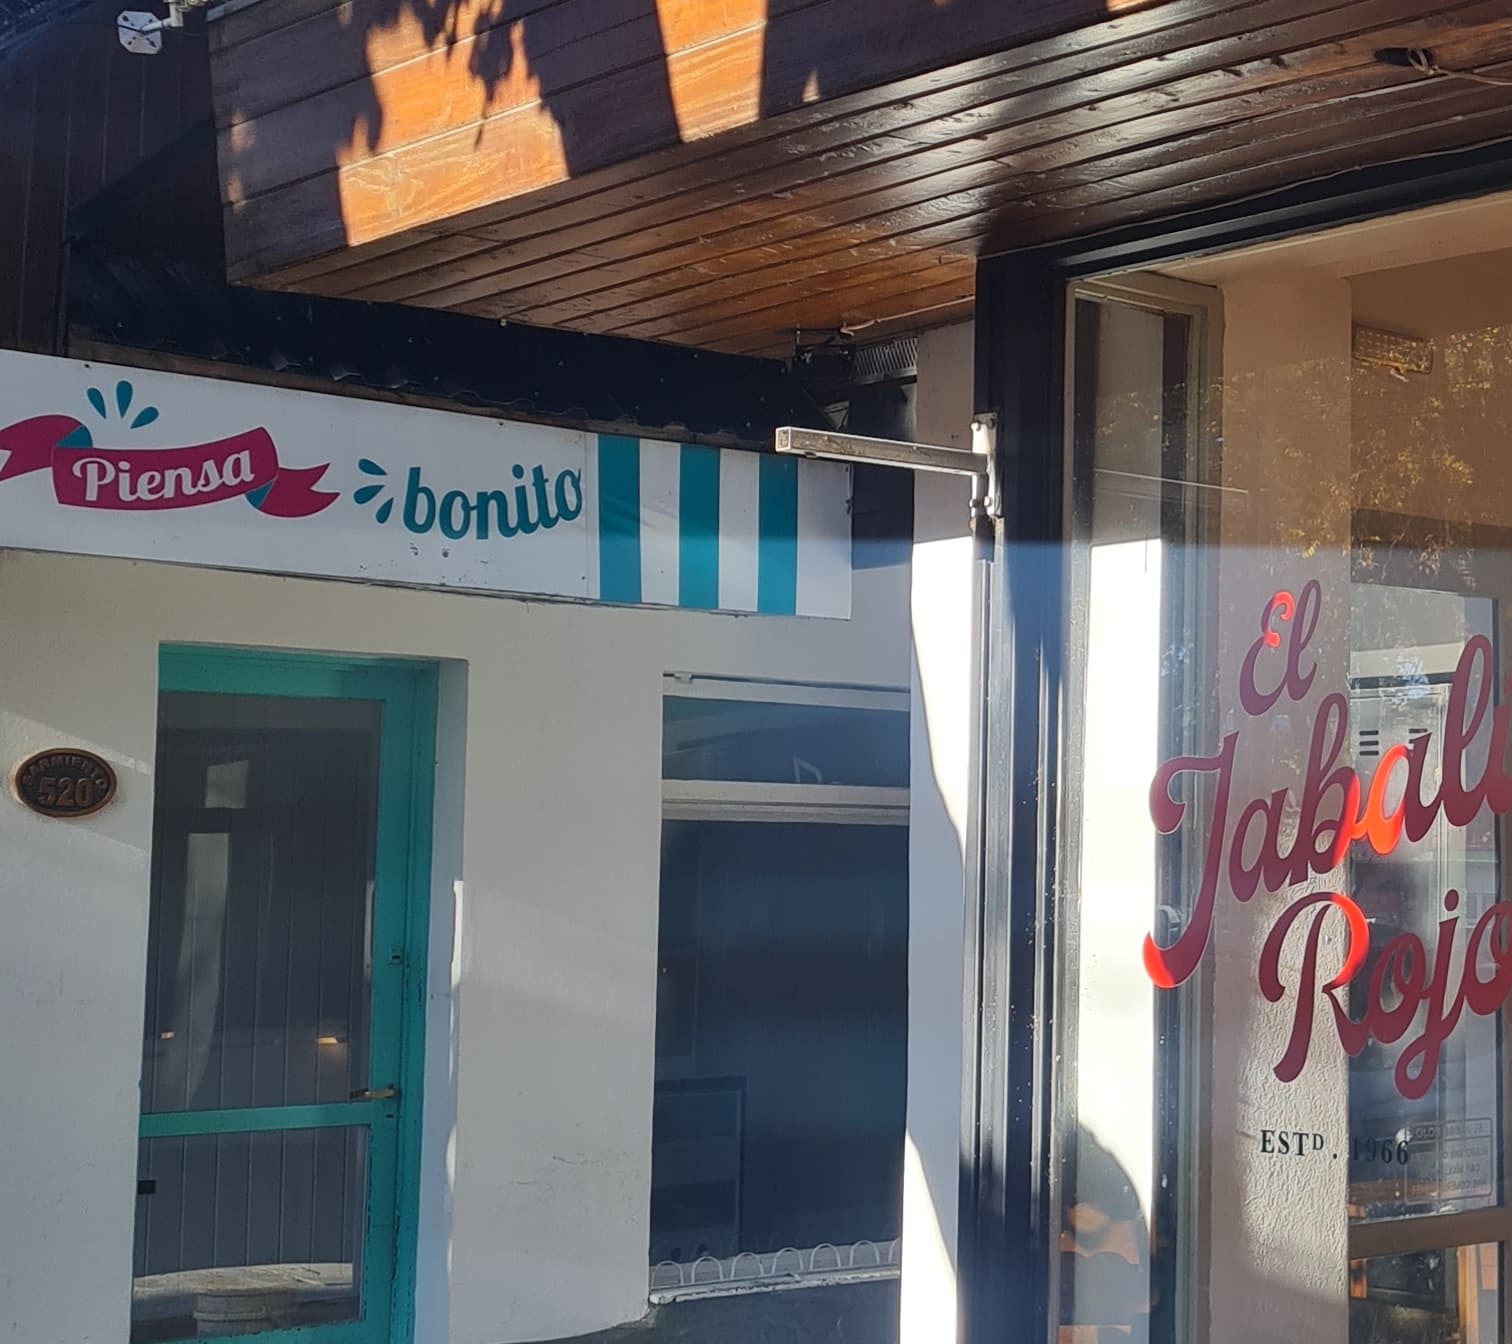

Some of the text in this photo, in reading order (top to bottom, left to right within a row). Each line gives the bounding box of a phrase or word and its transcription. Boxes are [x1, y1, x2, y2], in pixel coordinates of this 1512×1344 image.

[72, 444, 256, 504] Piensa
[402, 464, 585, 541] bonito
[1238, 578, 1322, 716] El
[38, 776, 92, 808] 520
[1351, 1135, 1410, 1166] 1966
